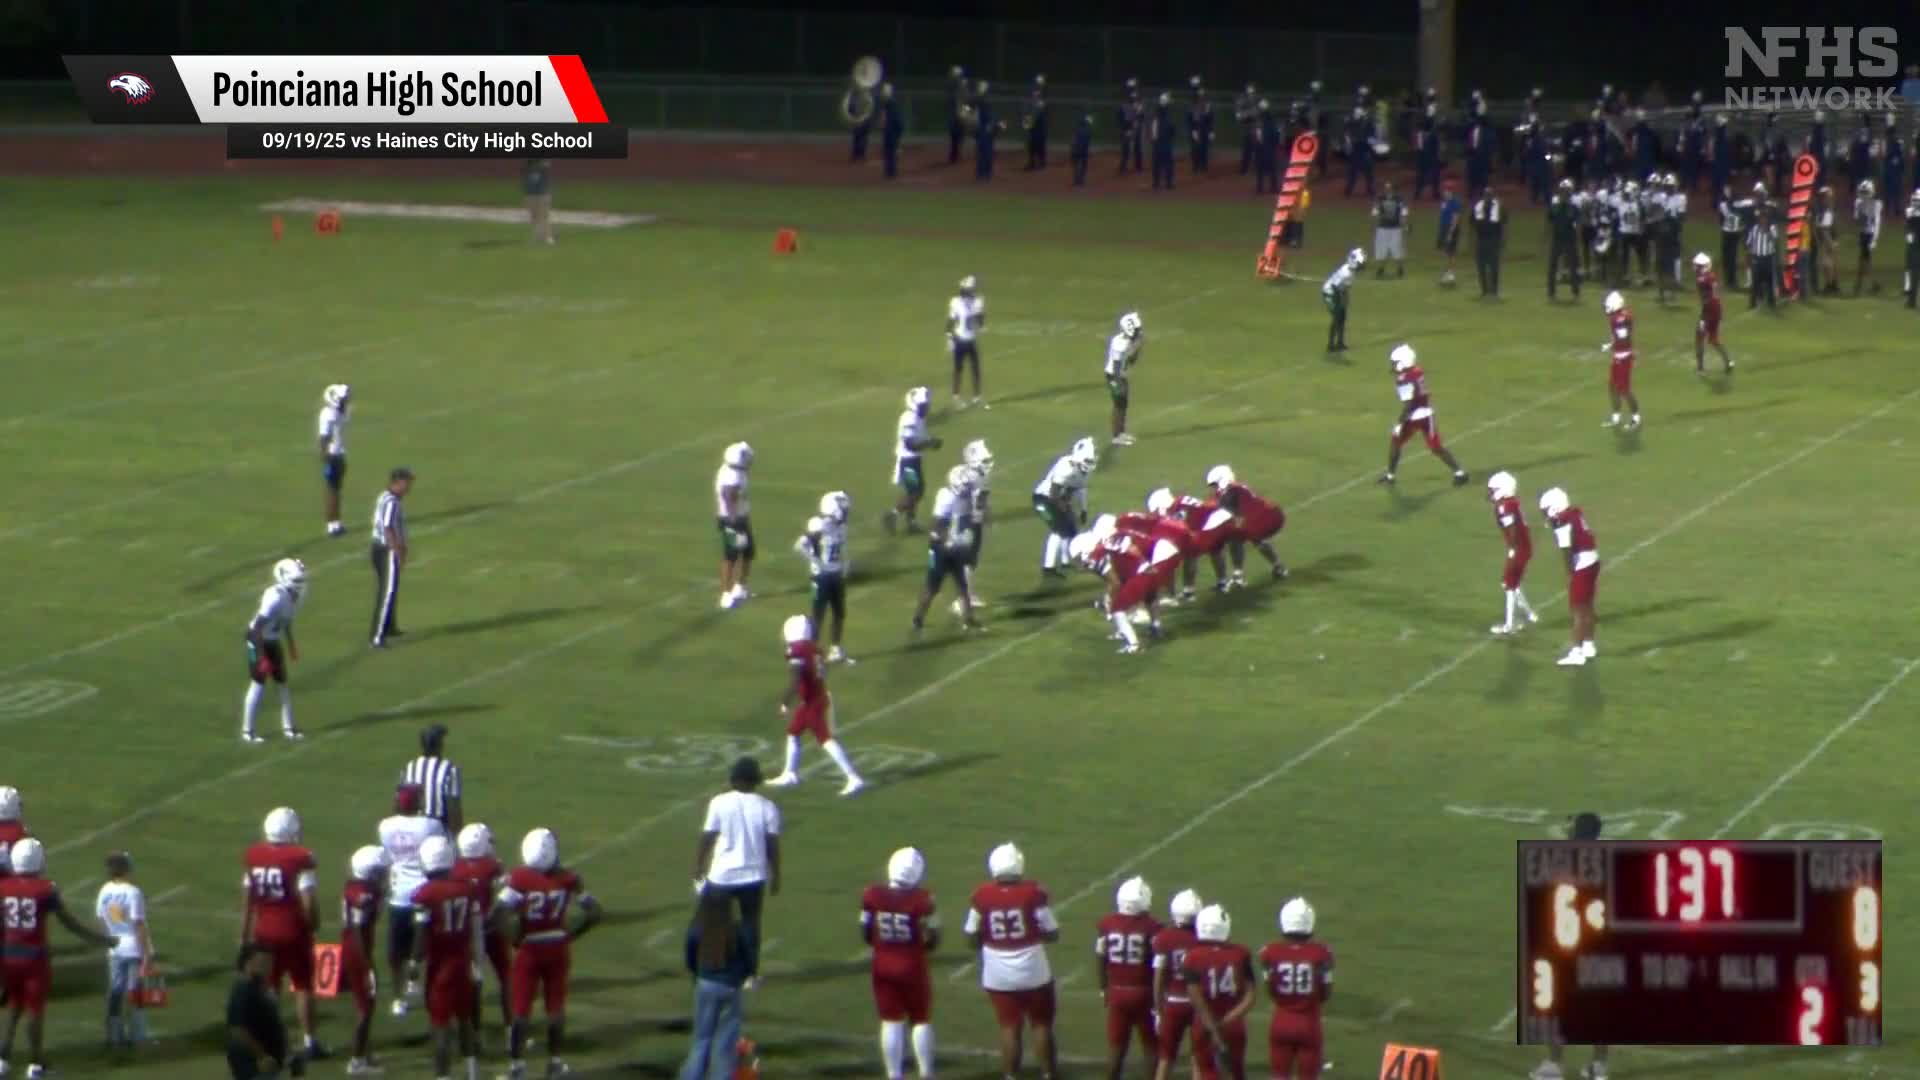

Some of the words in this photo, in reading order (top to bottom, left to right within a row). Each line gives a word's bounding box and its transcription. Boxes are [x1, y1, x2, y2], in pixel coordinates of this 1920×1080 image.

[5, 895, 37, 929] 33
[443, 895, 470, 931] 17
[526, 889, 566, 921] 27
[876, 911, 912, 942] 55
[989, 908, 1026, 941] 63
[1207, 965, 1238, 997] 14
[1383, 1049, 1431, 1080] 40
